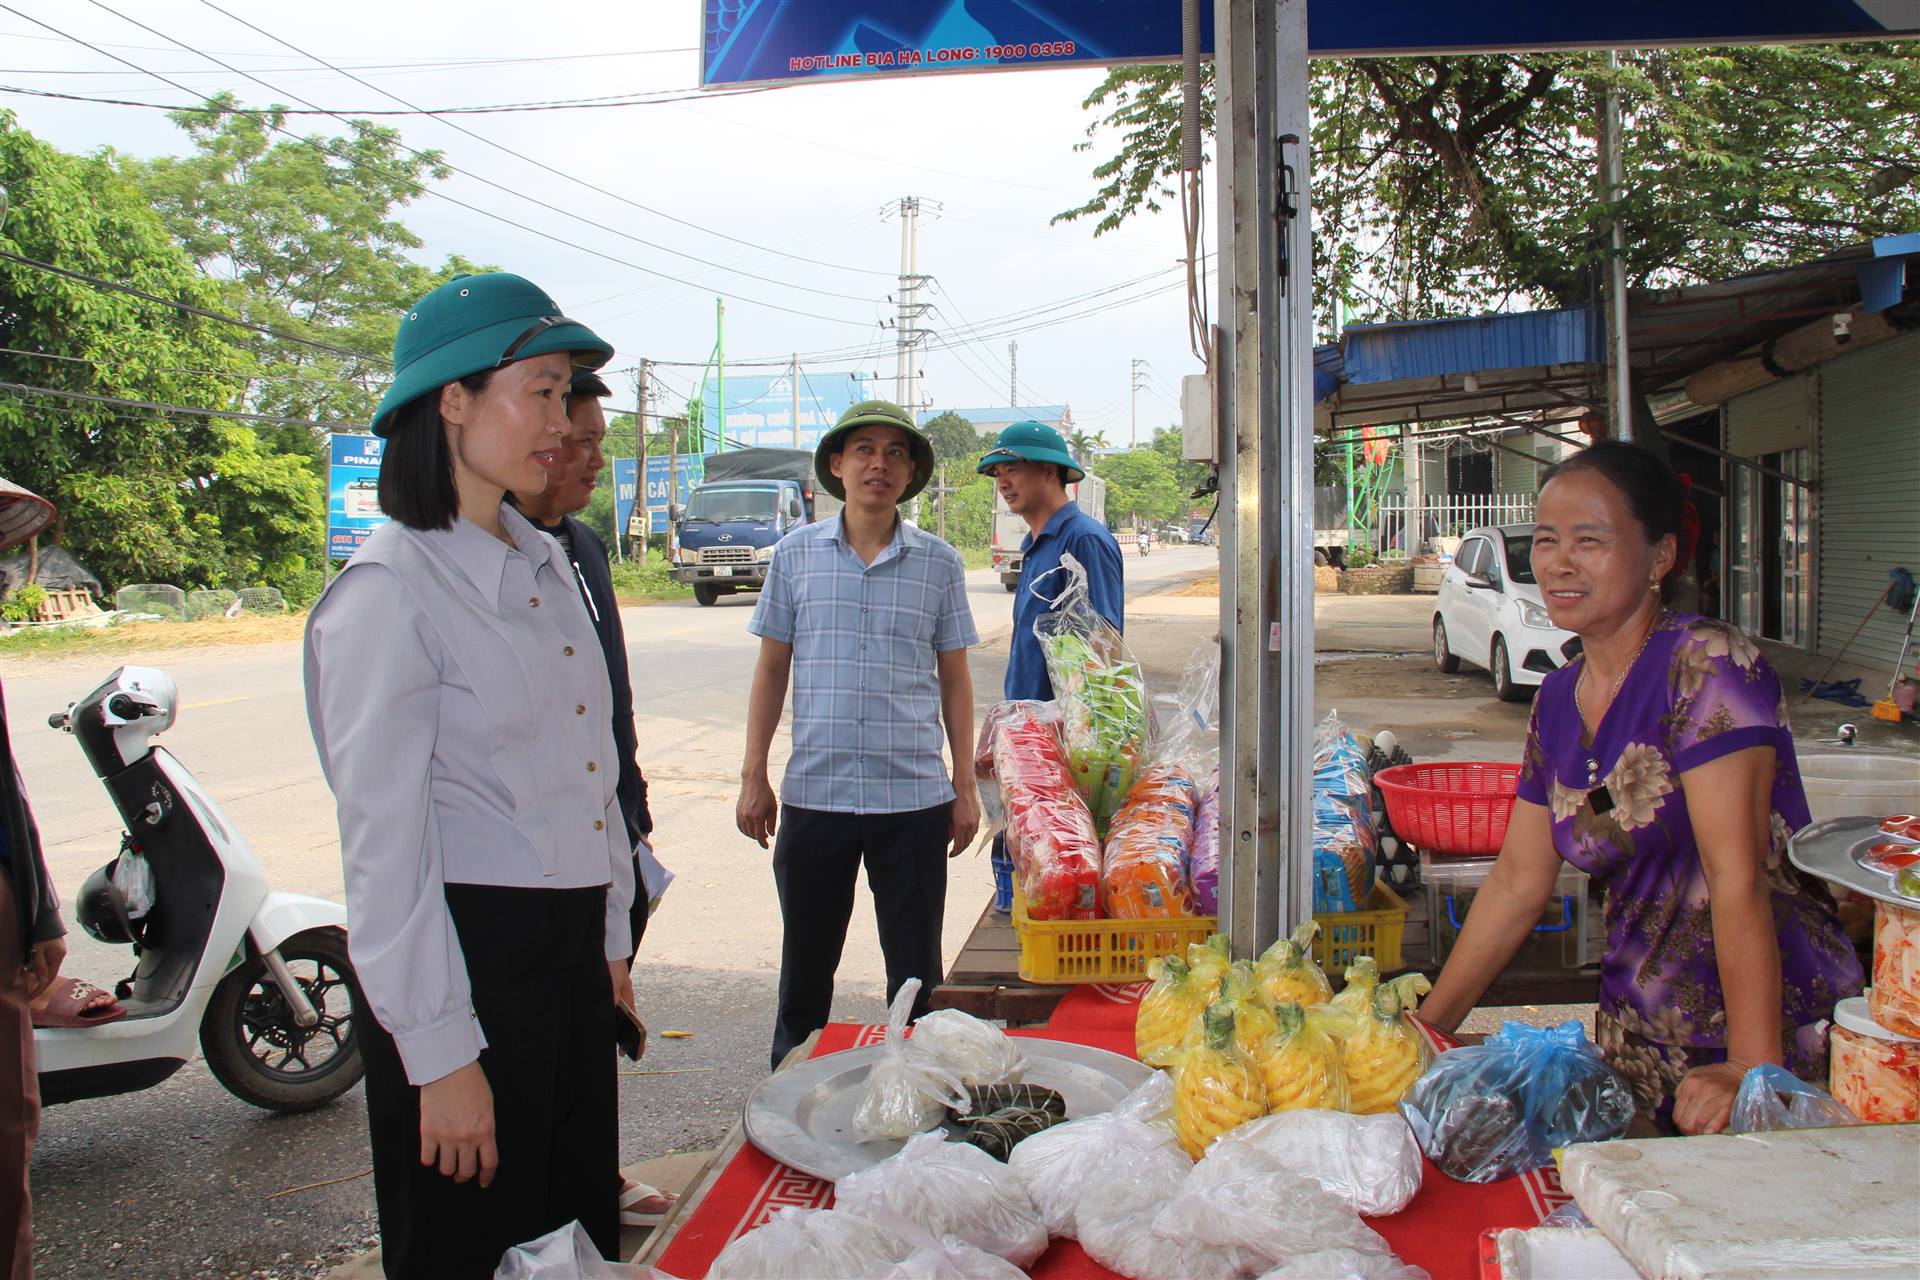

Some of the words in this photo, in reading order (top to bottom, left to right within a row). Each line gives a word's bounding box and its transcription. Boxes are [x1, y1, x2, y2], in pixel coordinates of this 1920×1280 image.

[789, 53, 863, 71] HOTLINE
[865, 51, 896, 66] BIA
[897, 49, 923, 67] HẠ
[926, 47, 980, 63] LONG:
[984, 44, 1026, 59] 1900
[1029, 41, 1075, 57] 0358
[343, 455, 382, 465] PINA
